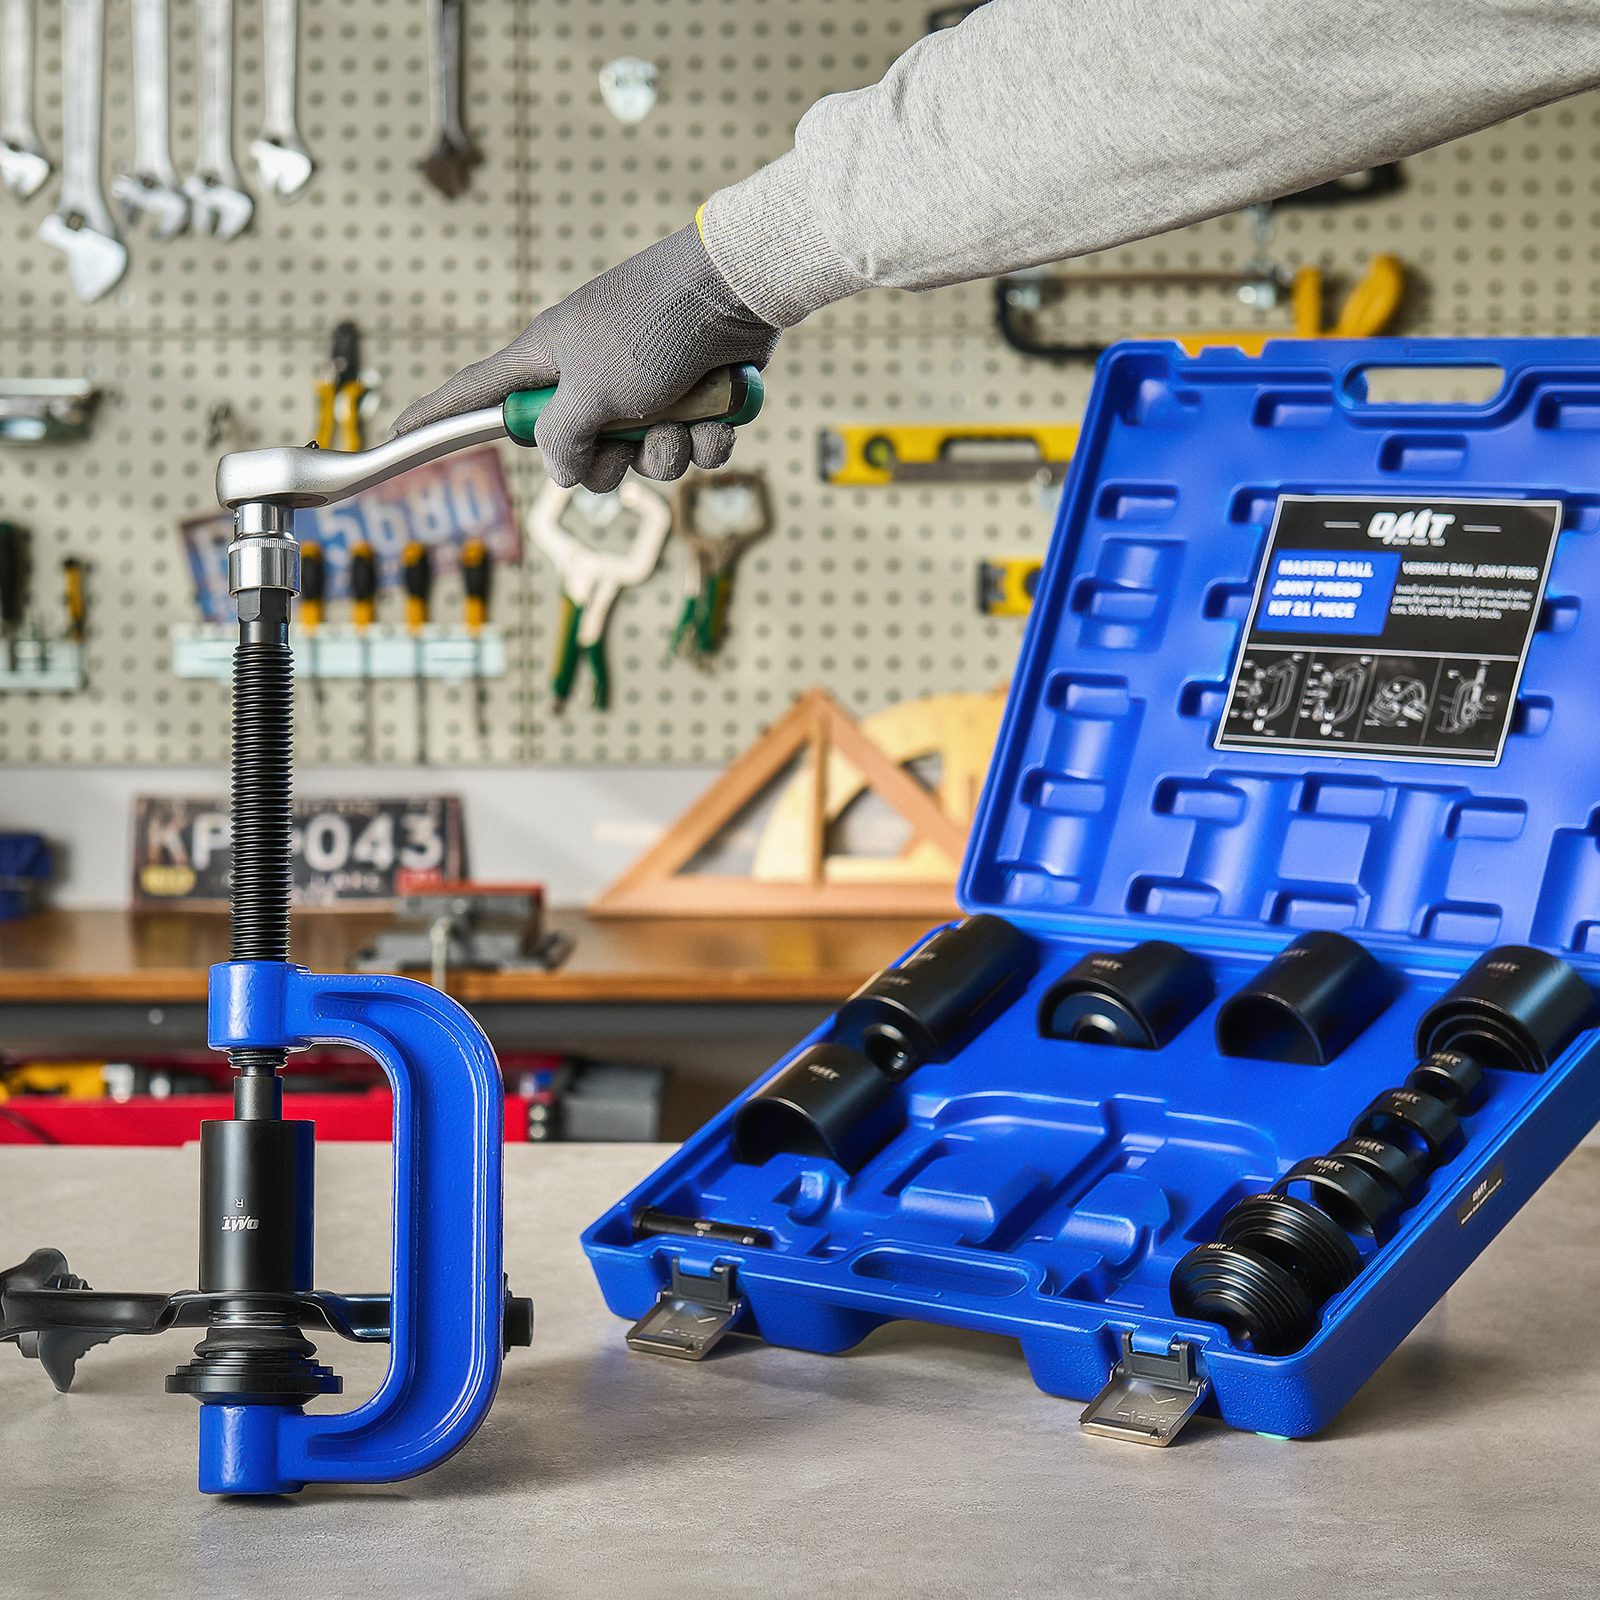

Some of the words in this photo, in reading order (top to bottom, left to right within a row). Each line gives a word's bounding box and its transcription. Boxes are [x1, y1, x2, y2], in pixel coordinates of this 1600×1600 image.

[1367, 508, 1456, 545] OMT
[1278, 559, 1337, 577] MASTER
[1337, 560, 1374, 578] BALL
[1449, 562, 1474, 578] BALL
[1474, 564, 1507, 579] JOINT
[1507, 566, 1539, 581] PRESS
[1272, 579, 1314, 597] JOINT
[1314, 580, 1363, 598] PRESS
[1268, 600, 1292, 616] KIT
[1291, 600, 1311, 617] 21
[1312, 601, 1357, 618] PIECE
[235, 1198, 244, 1208] R
[221, 1215, 259, 1232] OMT
